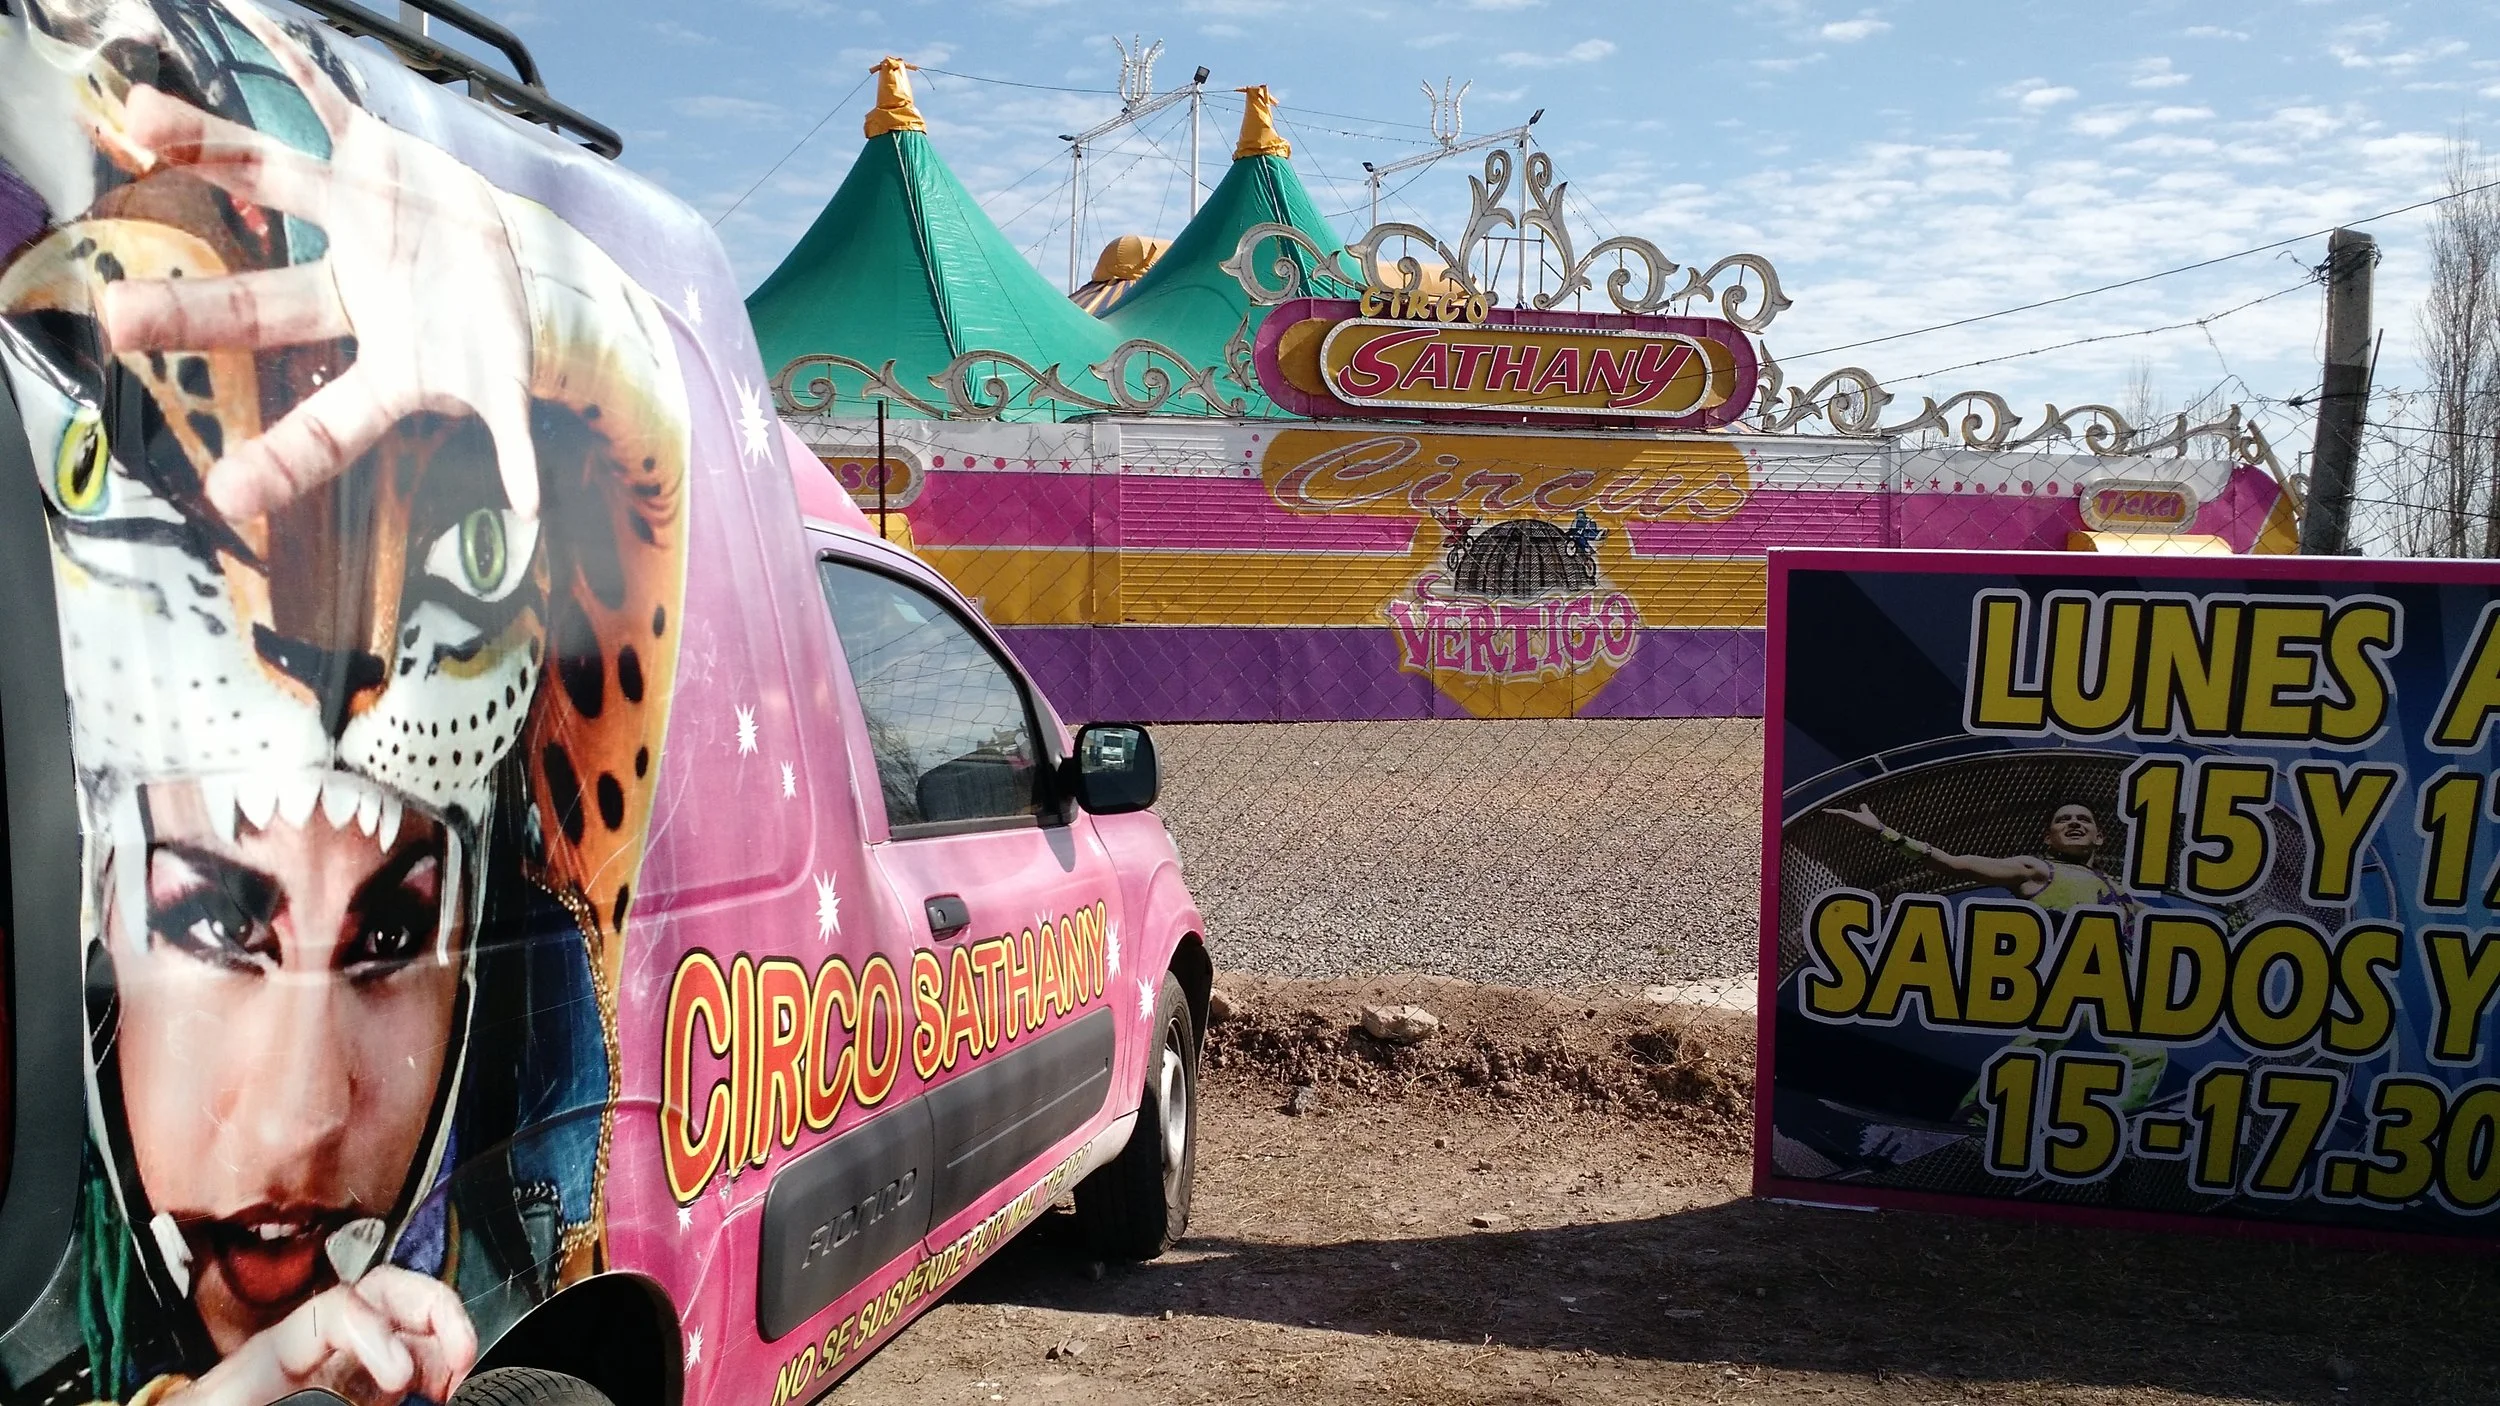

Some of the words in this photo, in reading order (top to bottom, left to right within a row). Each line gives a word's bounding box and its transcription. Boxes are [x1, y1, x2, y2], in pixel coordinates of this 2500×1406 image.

[1337, 328, 1695, 409] SATHANY
[1360, 286, 1488, 324] CIRCO
[1273, 434, 1748, 518] Circus
[1387, 576, 1641, 677] VERTIGO
[1963, 589, 2403, 747] LUNES
[2119, 752, 2278, 900] 15
[2288, 760, 2402, 905] Y
[658, 949, 904, 1206] CIRCO
[912, 899, 1108, 1080] SATHANY
[1801, 889, 2403, 1057] SABADOS
[2415, 924, 2500, 1067] Y
[770, 1345, 818, 1406] NO
[815, 1314, 856, 1380] SE
[852, 1231, 969, 1351] SUSPENDE
[965, 1211, 1007, 1265] POR
[1004, 1184, 1039, 1235] MAL
